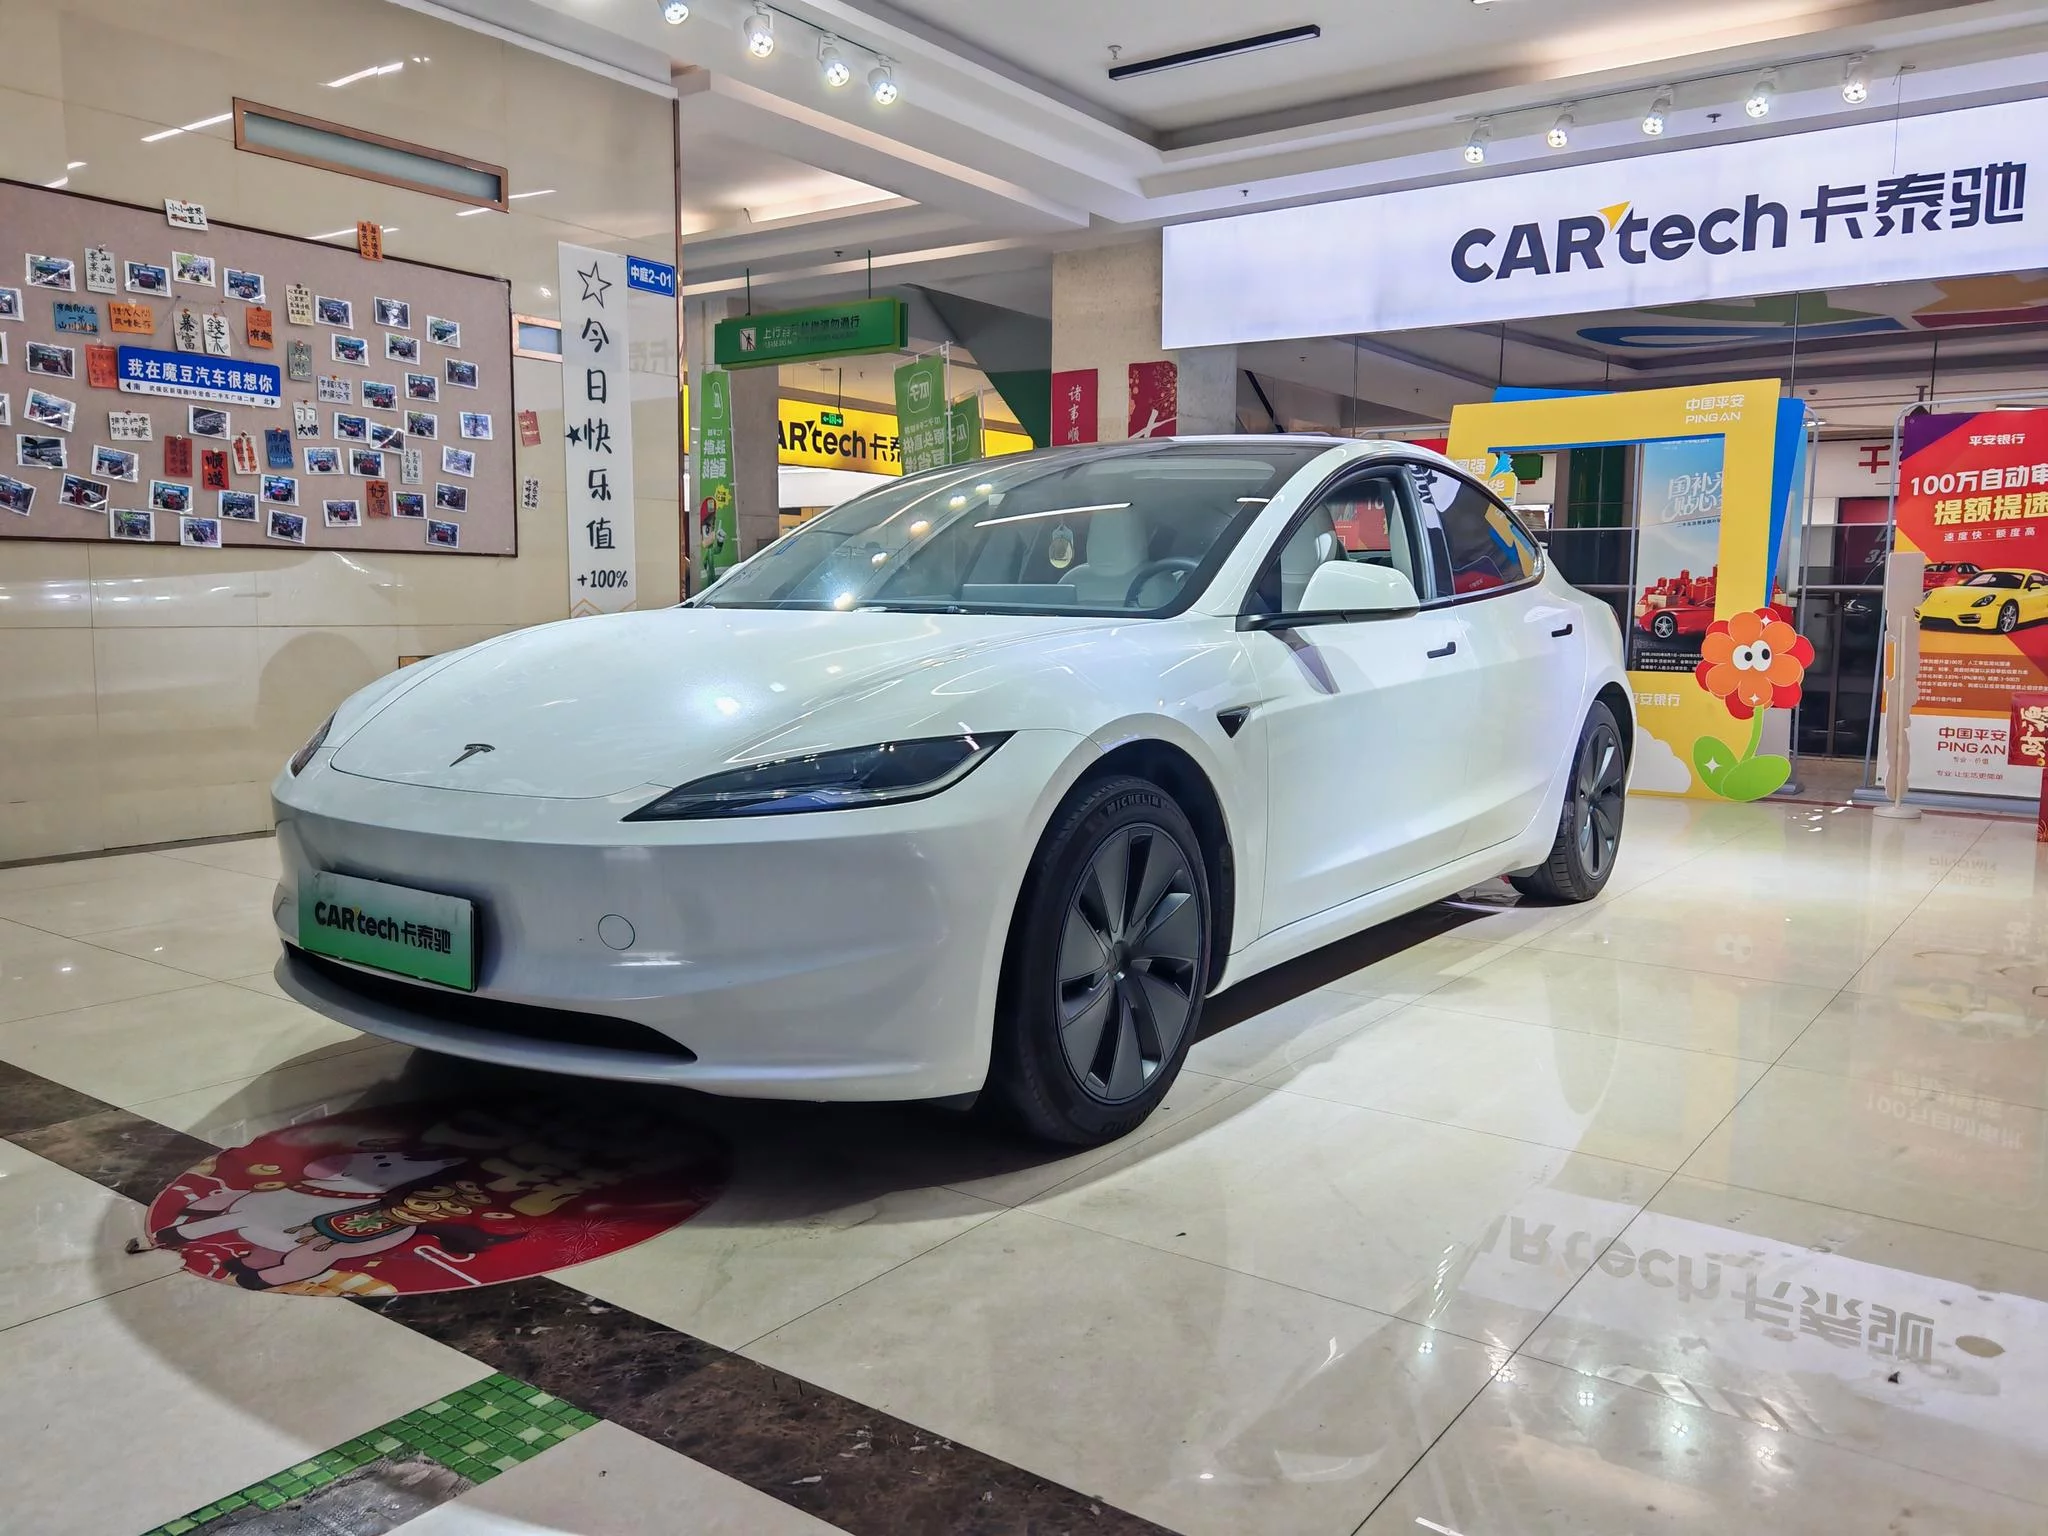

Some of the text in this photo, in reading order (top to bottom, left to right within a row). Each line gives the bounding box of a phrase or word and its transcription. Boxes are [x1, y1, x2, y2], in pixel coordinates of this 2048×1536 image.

[1452, 161, 2028, 284] CARtech 卡泰驰
[630, 264, 672, 288] 中庭2-01
[127, 357, 273, 394] 我在魔豆汽车很想你
[1685, 394, 1745, 412] 中国平安
[580, 317, 616, 550] 今日快乐值
[1968, 433, 2026, 446] 平安银行
[577, 569, 629, 589] +100%
[1938, 726, 2008, 742] 中国平安
[314, 901, 453, 954] CARtech 卡泰驰
